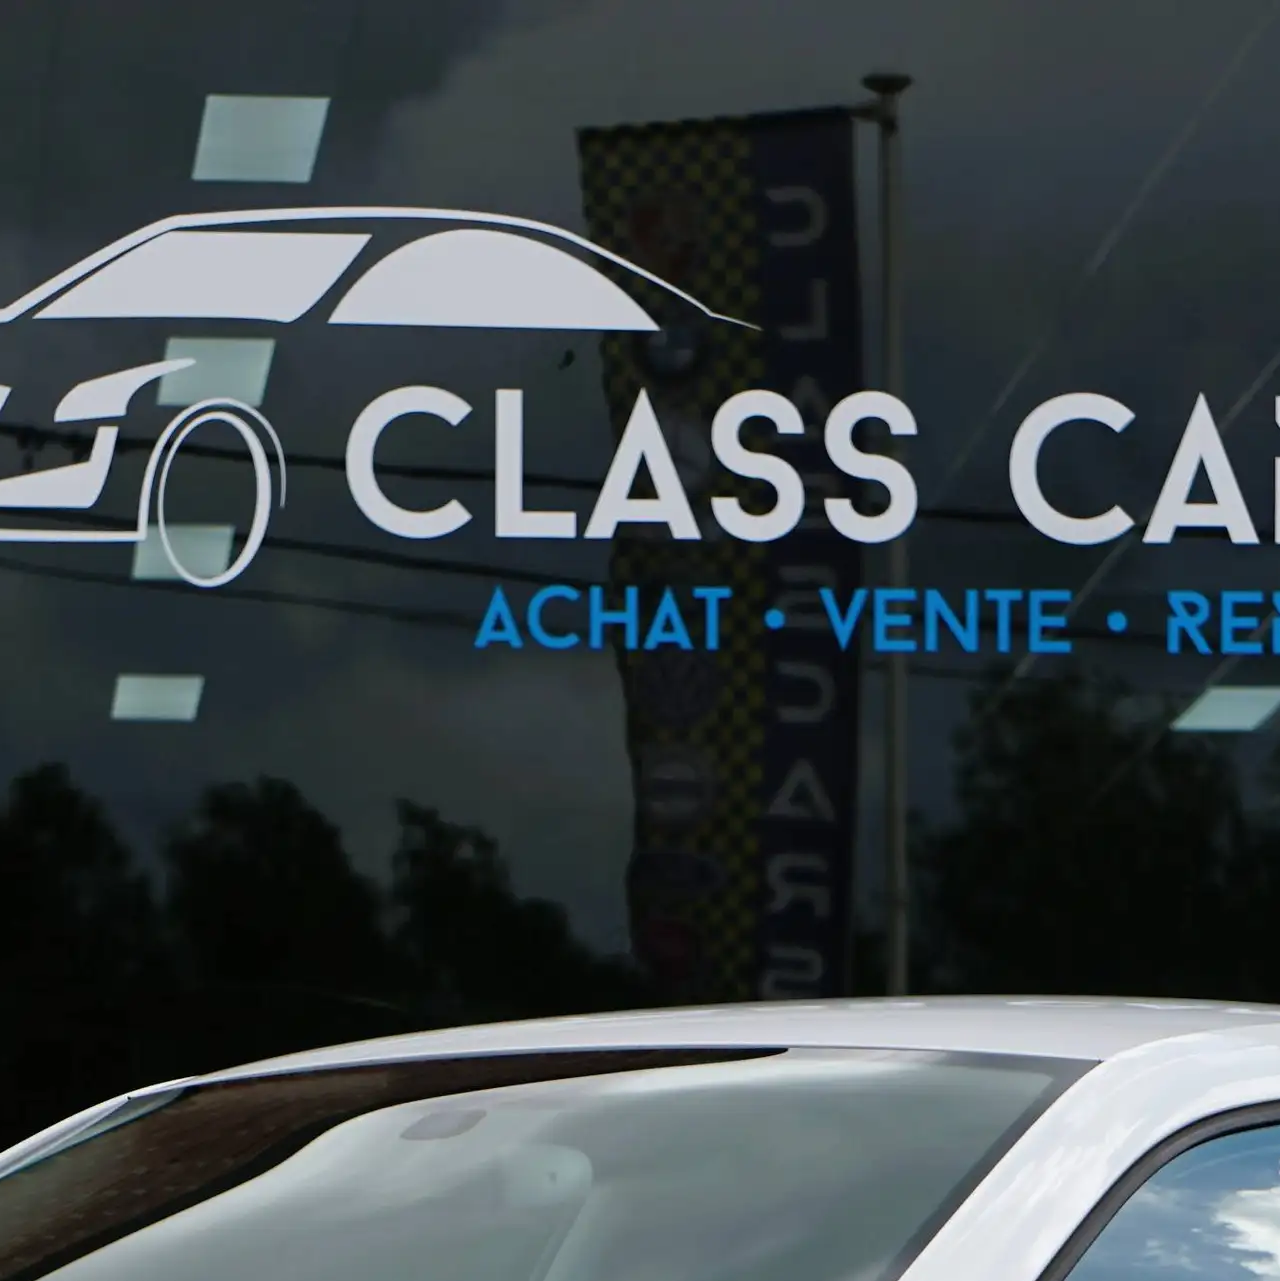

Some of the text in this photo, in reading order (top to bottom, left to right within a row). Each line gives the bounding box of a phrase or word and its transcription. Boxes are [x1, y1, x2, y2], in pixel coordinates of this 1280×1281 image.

[346, 386, 918, 543] CLASS
[473, 585, 732, 650] ACHAT
[820, 588, 1073, 653] VENTE
